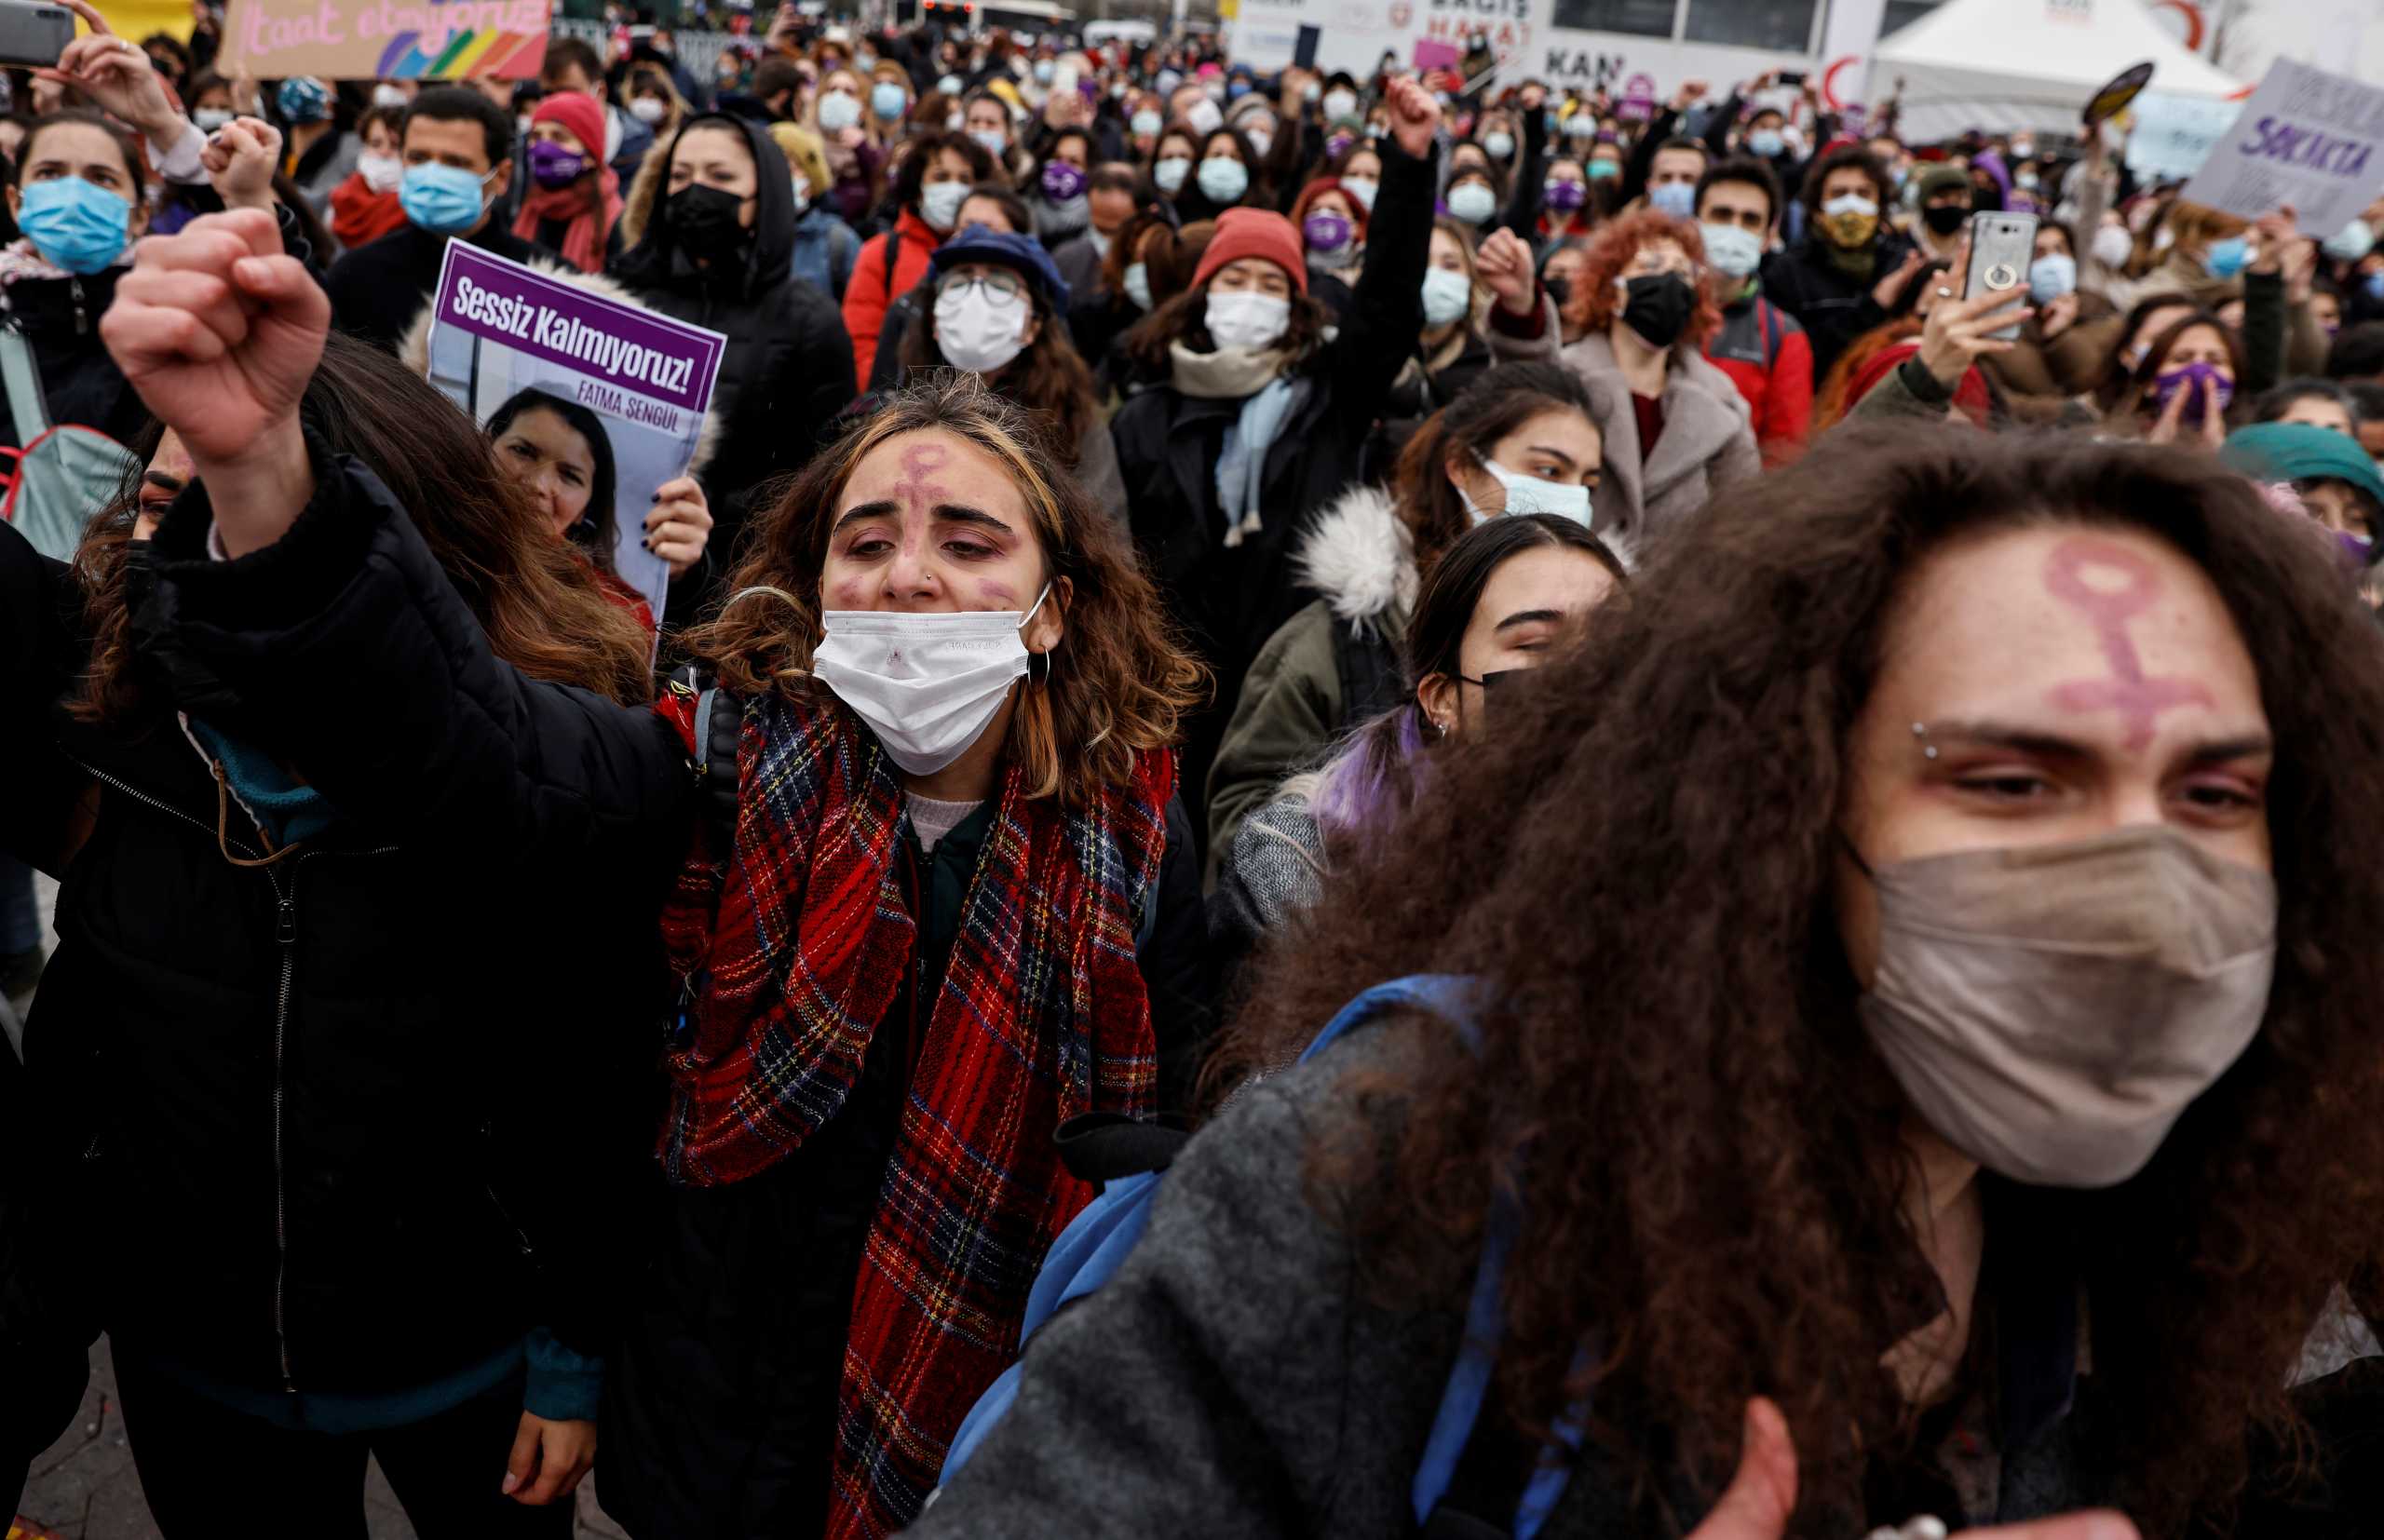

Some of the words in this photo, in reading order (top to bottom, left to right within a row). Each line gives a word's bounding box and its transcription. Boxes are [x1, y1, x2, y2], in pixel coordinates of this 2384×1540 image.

[453, 276, 535, 340] Sessiz
[533, 305, 695, 395] Kalmıyoruz!
[576, 380, 621, 413] FATMA
